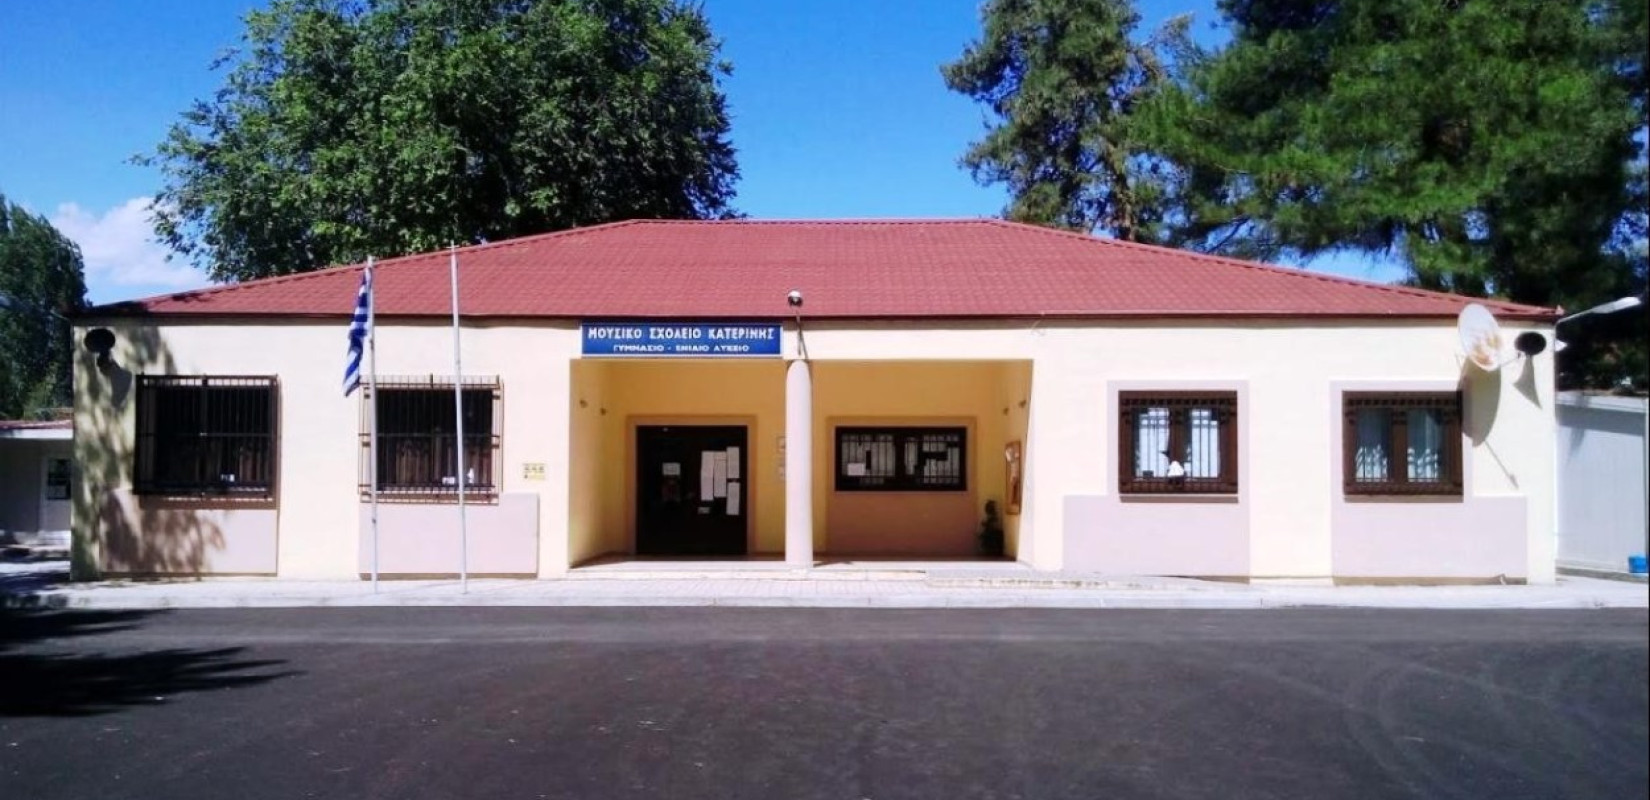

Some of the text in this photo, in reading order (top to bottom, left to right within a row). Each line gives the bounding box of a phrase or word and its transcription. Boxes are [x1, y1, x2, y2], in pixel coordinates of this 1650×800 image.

[588, 327, 775, 339] ΜΟΥΣΙΚΟ ΣΧΟΛΕΙΟ ΚΑΤΕΡΙΝΗΣ
[613, 344, 665, 352] ΓΥΜΝΑΣΙΟ
[675, 344, 710, 352] ΕΝΙΑΙΟ
[713, 344, 750, 352] ΛΥΚΕΙΟ
